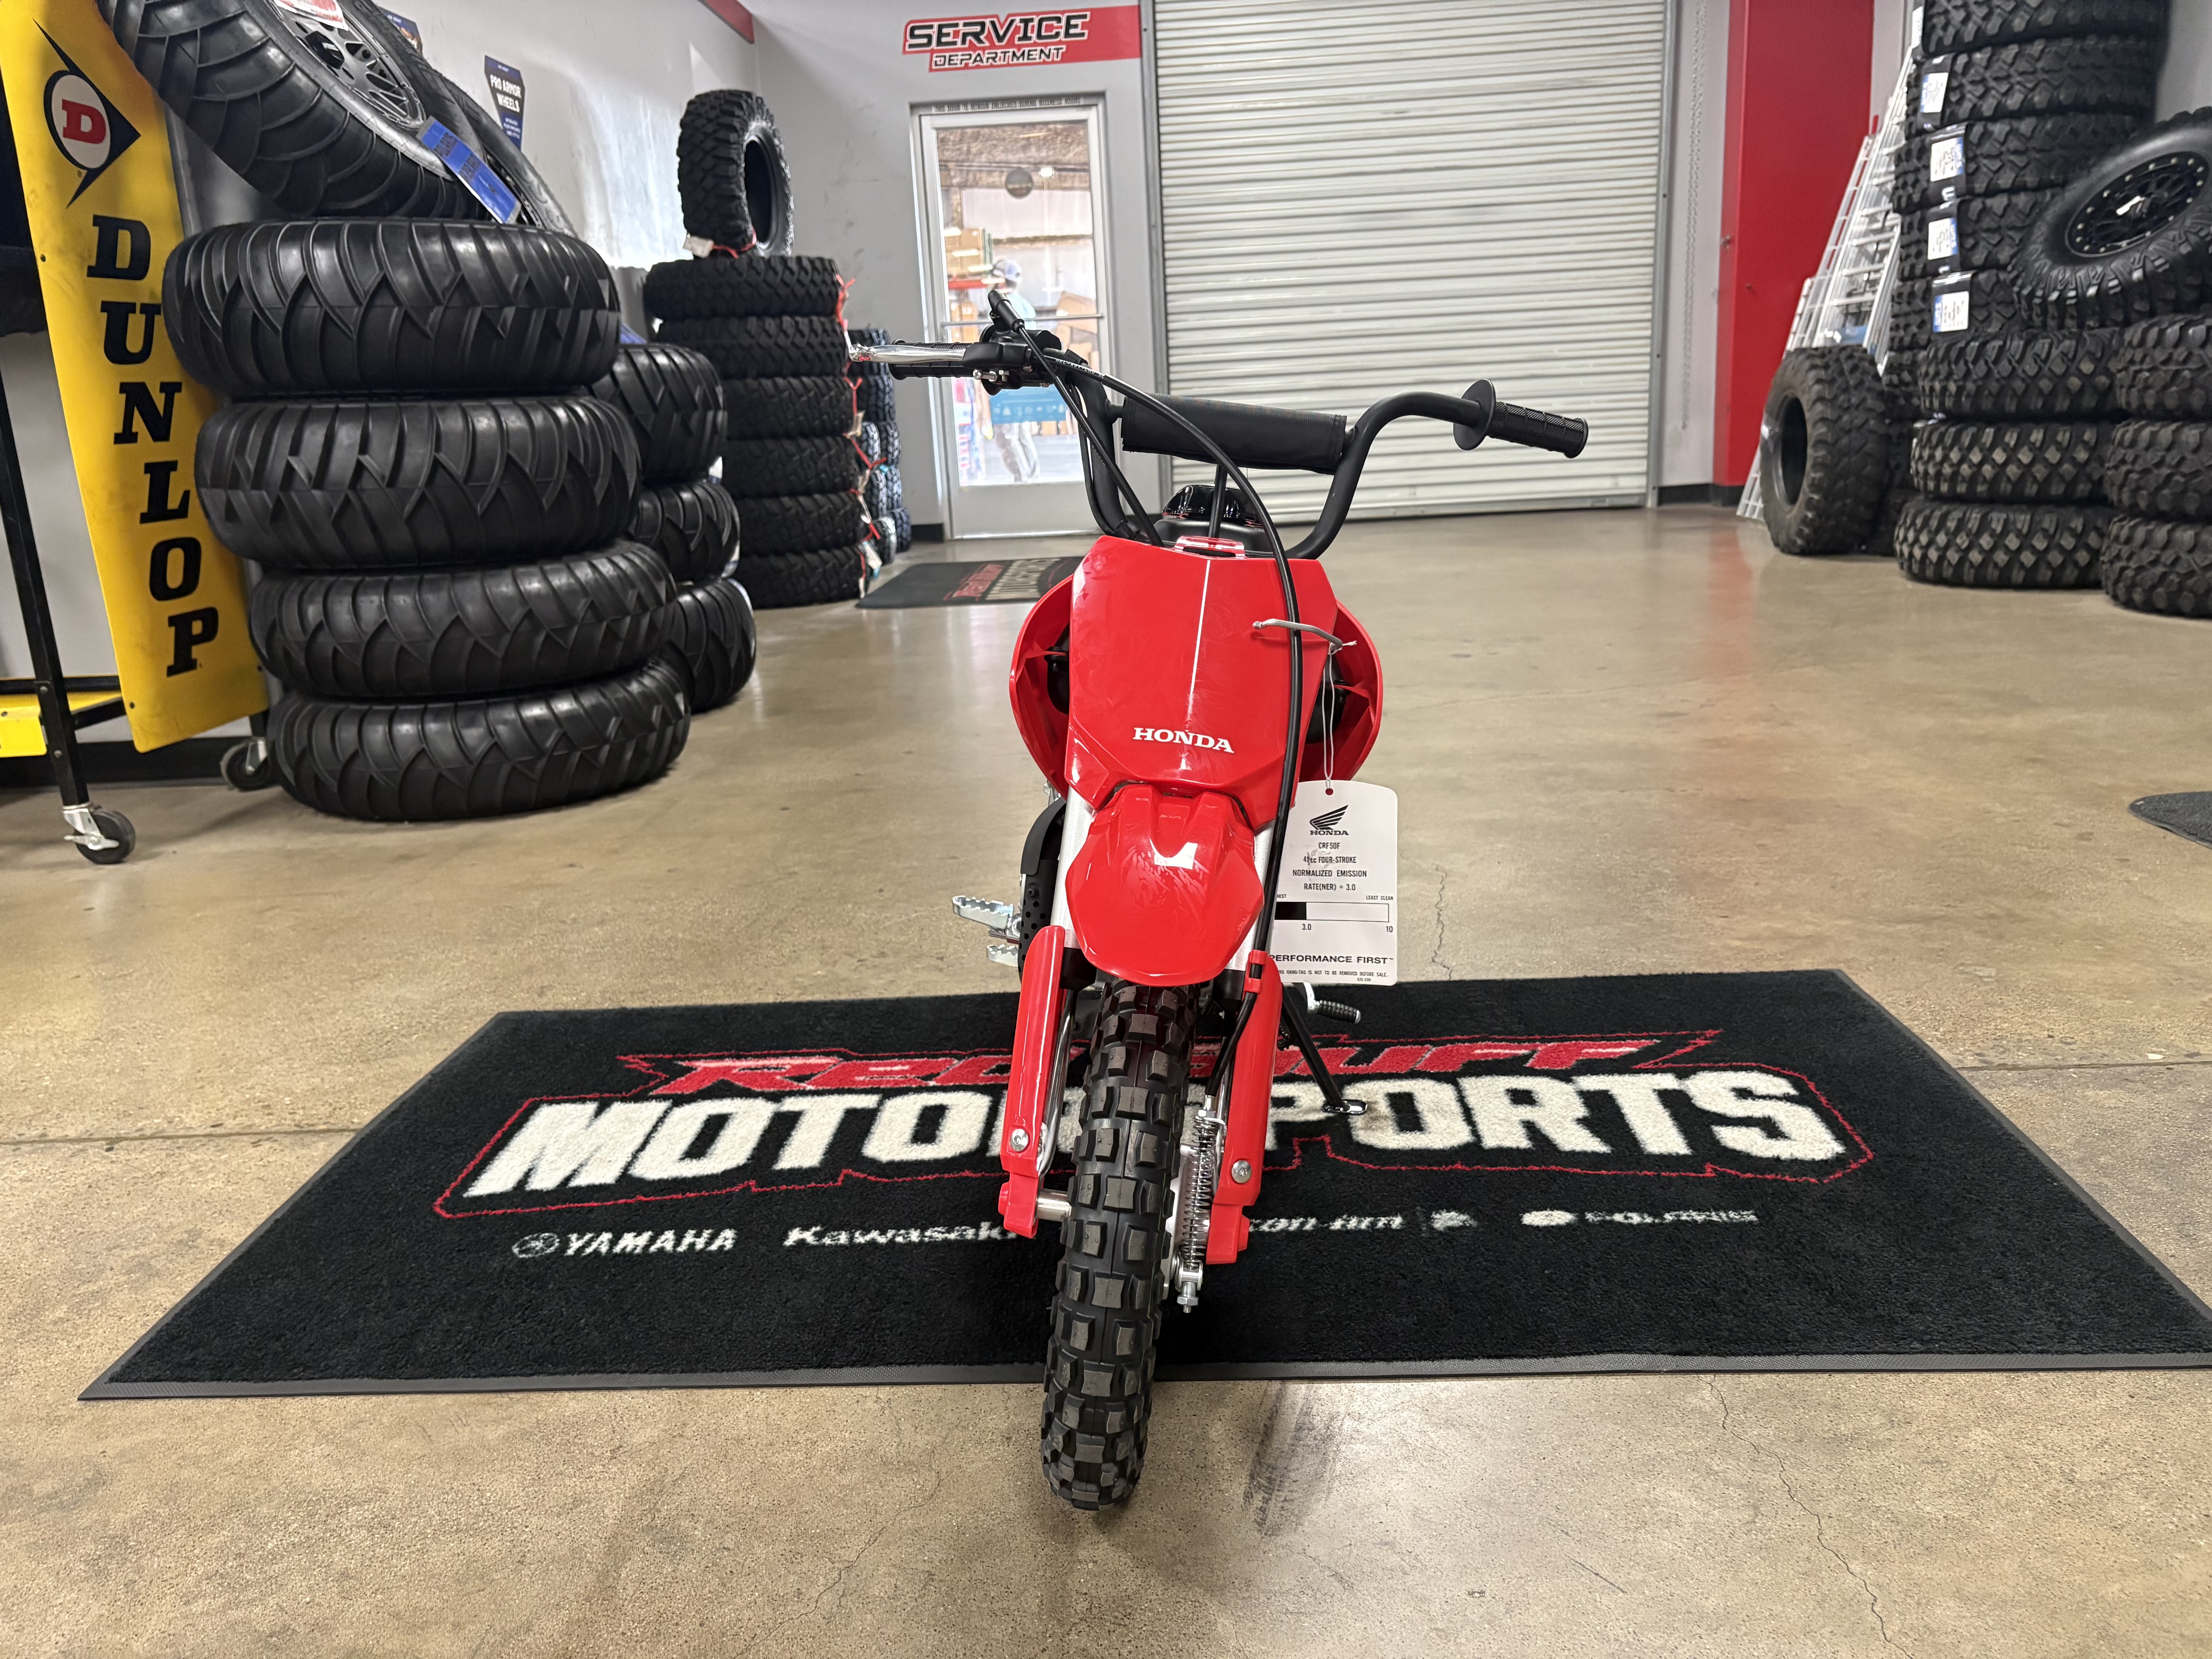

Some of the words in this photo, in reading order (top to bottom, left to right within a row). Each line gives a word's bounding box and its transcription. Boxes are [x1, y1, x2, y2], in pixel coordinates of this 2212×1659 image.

[907, 13, 1089, 50] SERVICE
[933, 46, 1065, 68] DEPARTMENT
[62, 99, 106, 144] D
[86, 214, 219, 677] DUNLOP
[1132, 727, 1234, 754] HONDA
[564, 1228, 737, 1256] YAMAHA
